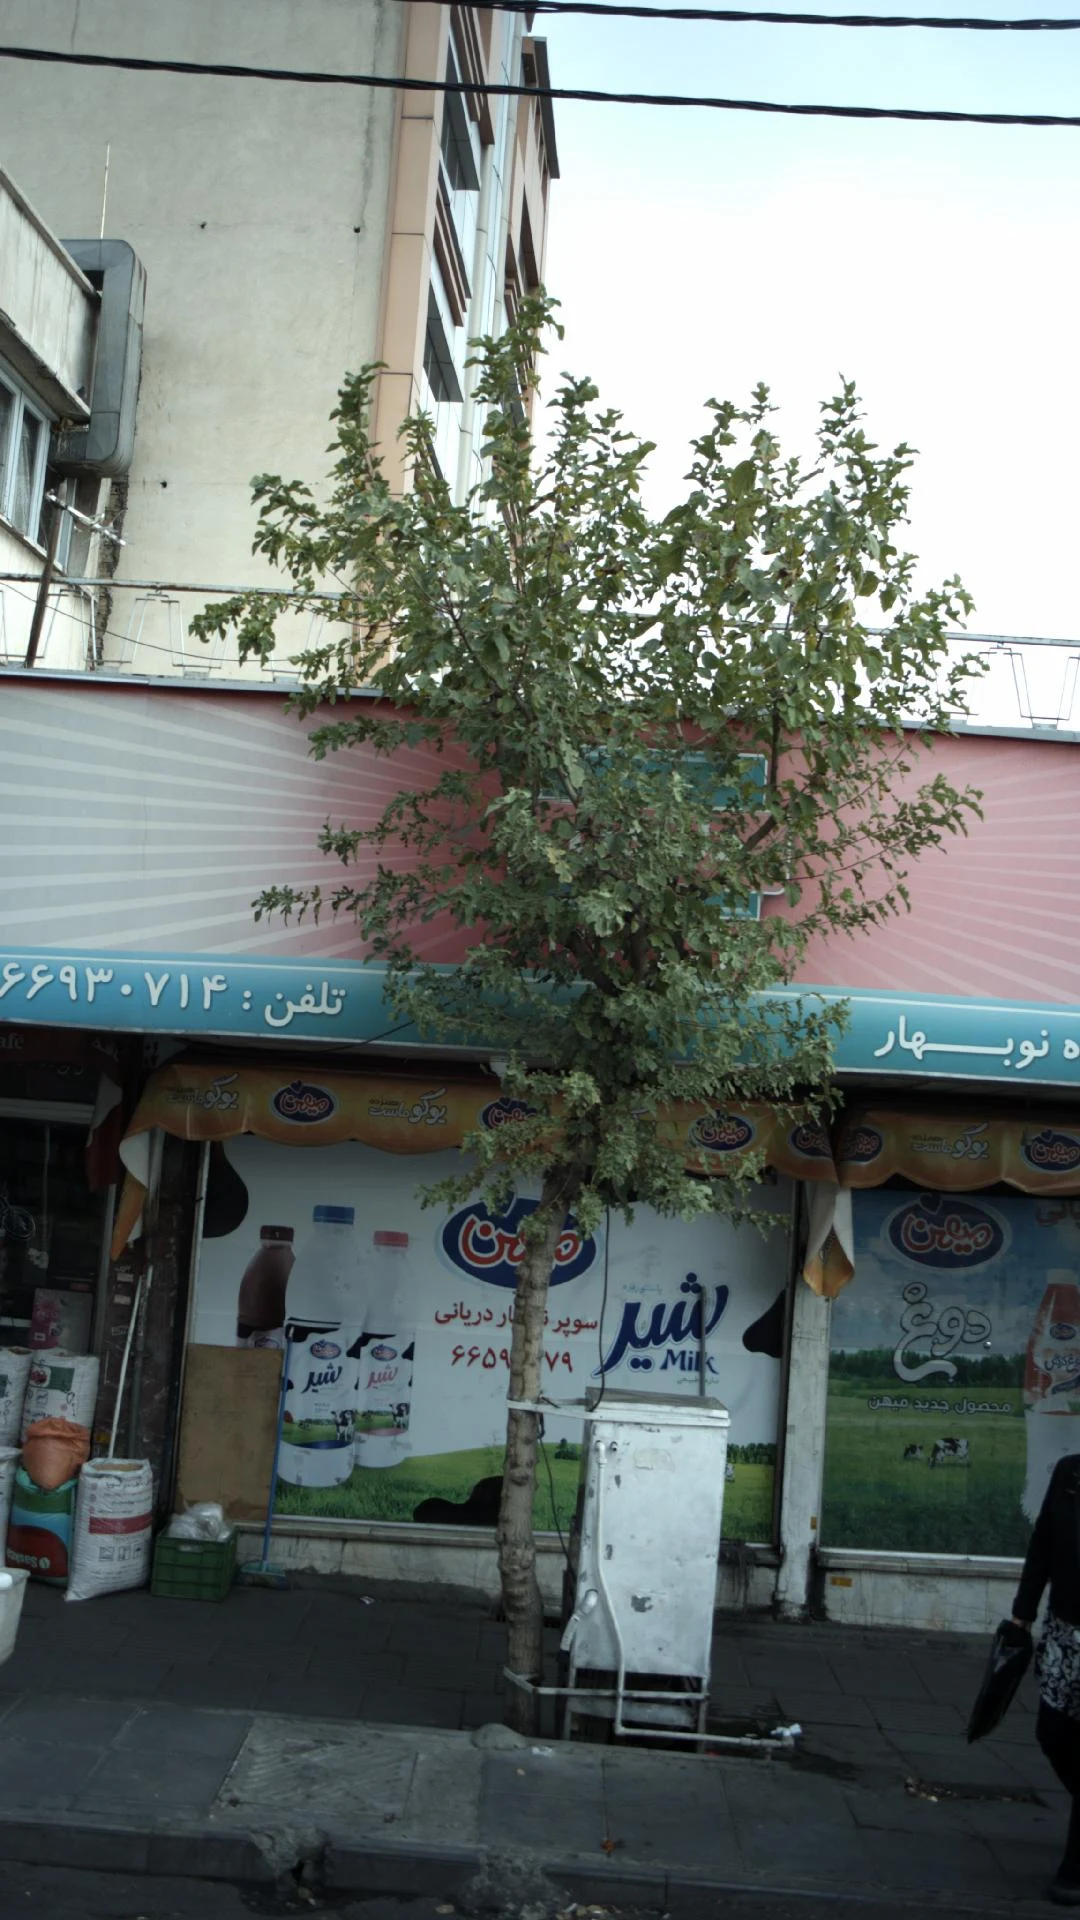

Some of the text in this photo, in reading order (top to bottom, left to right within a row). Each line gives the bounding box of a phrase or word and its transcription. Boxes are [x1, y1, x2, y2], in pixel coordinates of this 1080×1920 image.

[874, 1015, 1050, 1069] نوبهار
[900, 1213, 994, 1256] میهن
[435, 1301, 493, 1327] دریانی
[553, 1316, 598, 1336] سوپر
[594, 1272, 729, 1377] شیر
[660, 1350, 720, 1375] Milk
[868, 1393, 1013, 1415] محصول جدید میهن
